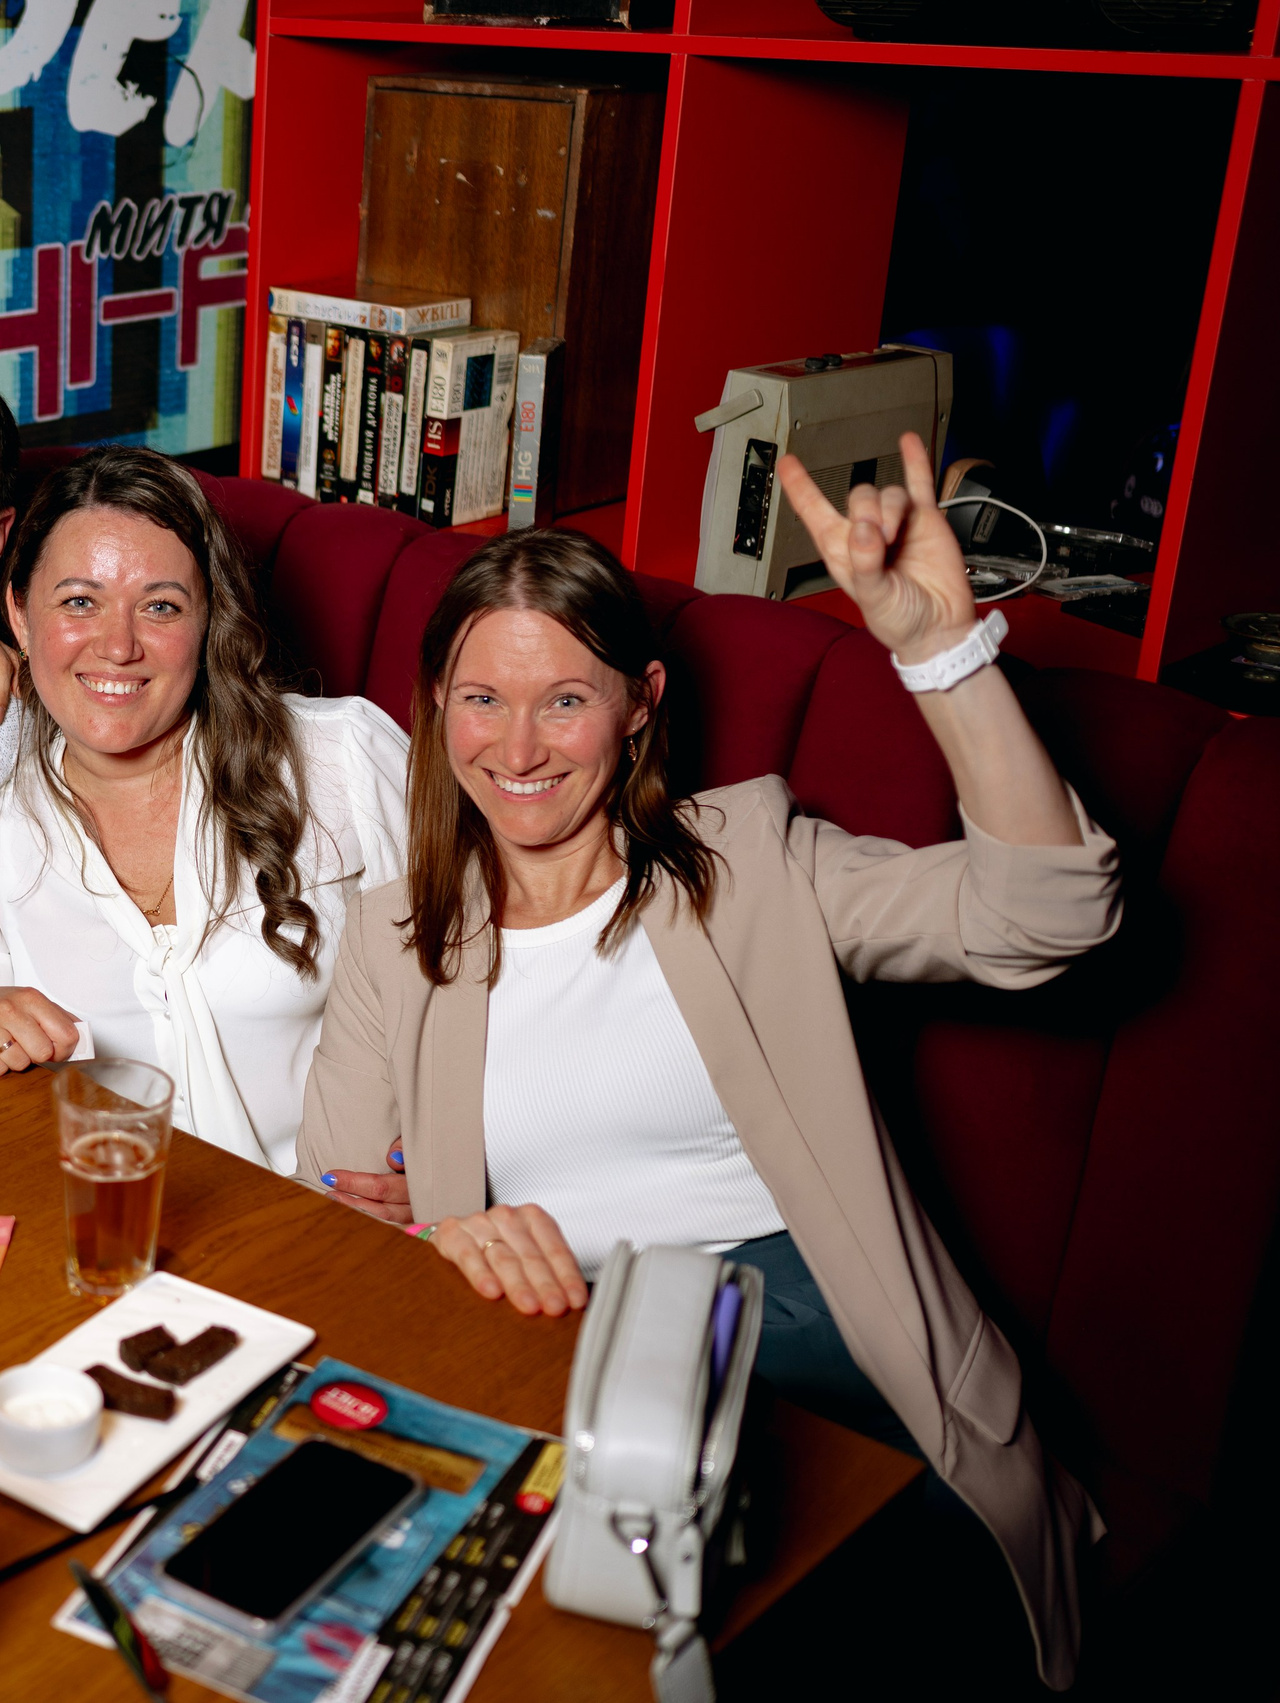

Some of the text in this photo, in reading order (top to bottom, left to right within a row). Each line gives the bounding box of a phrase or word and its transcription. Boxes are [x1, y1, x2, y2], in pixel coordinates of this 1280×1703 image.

[81, 190, 235, 263] МИТЯ
[362, 377, 378, 479] ПОЦЕЛУЙ ДРАКОНА
[519, 401, 536, 432] E180
[426, 420, 443, 450] HS
[517, 451, 532, 481] HG
